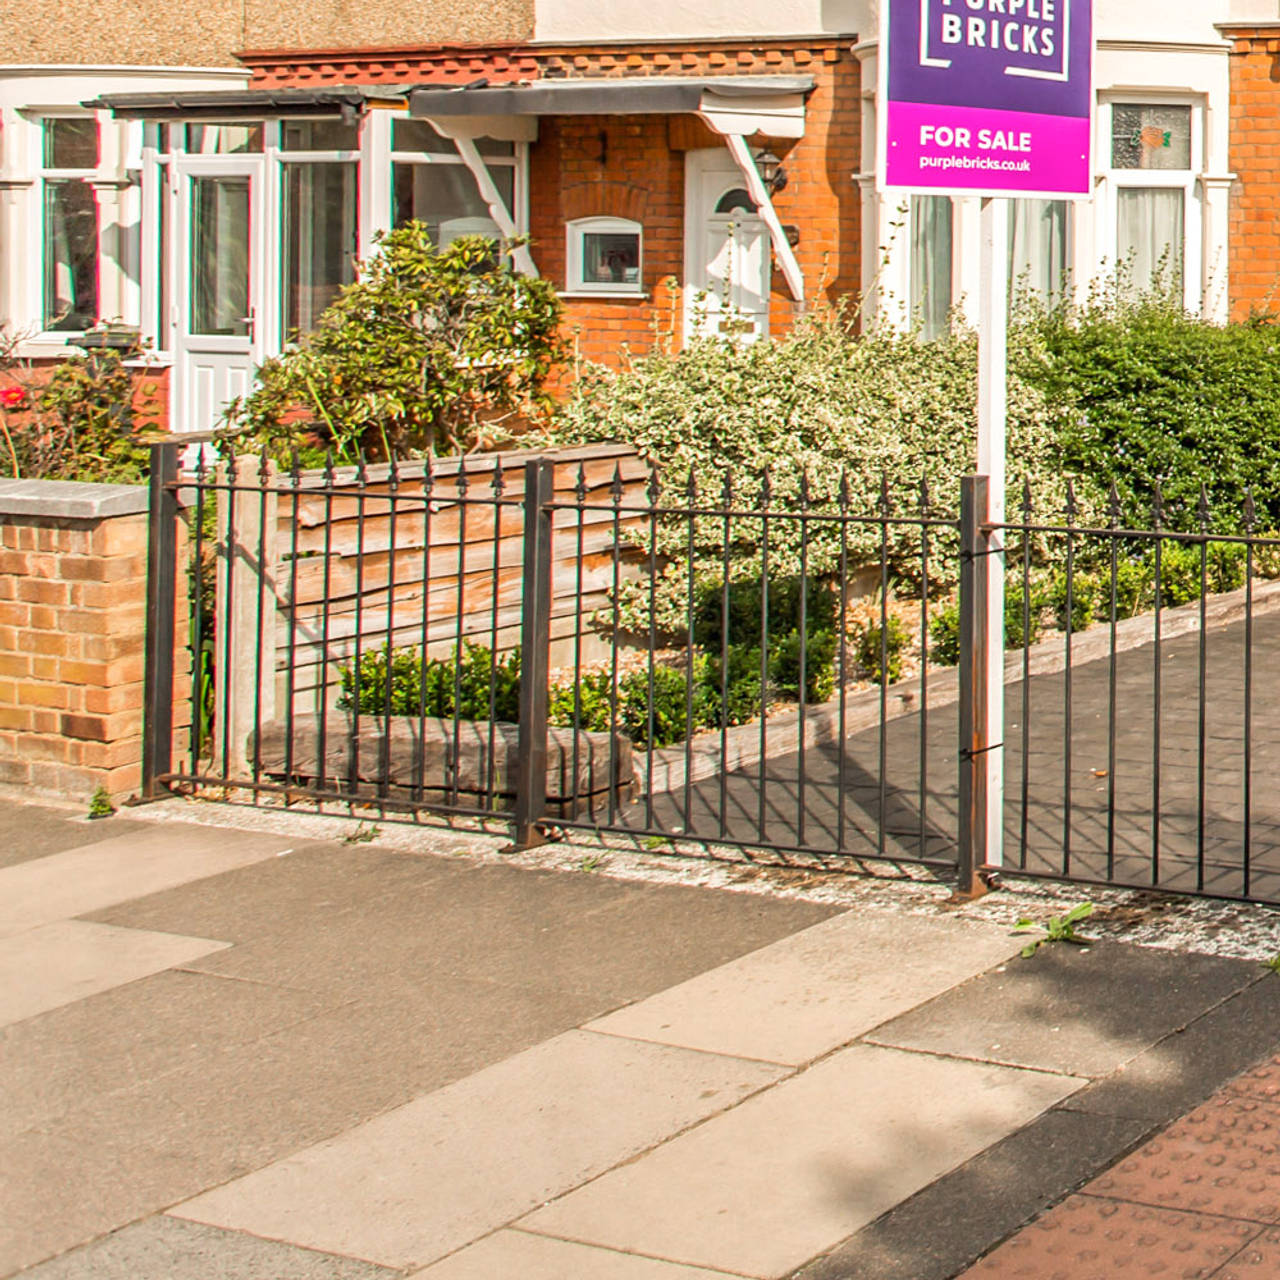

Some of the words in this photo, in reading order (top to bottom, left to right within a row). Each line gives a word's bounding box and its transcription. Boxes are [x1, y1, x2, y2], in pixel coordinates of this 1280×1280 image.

[942, 13, 1055, 56] BRICKS
[920, 125, 970, 148] FOR
[978, 129, 1031, 152] SALE
[920, 155, 1031, 171] purplebricks.co.uk
